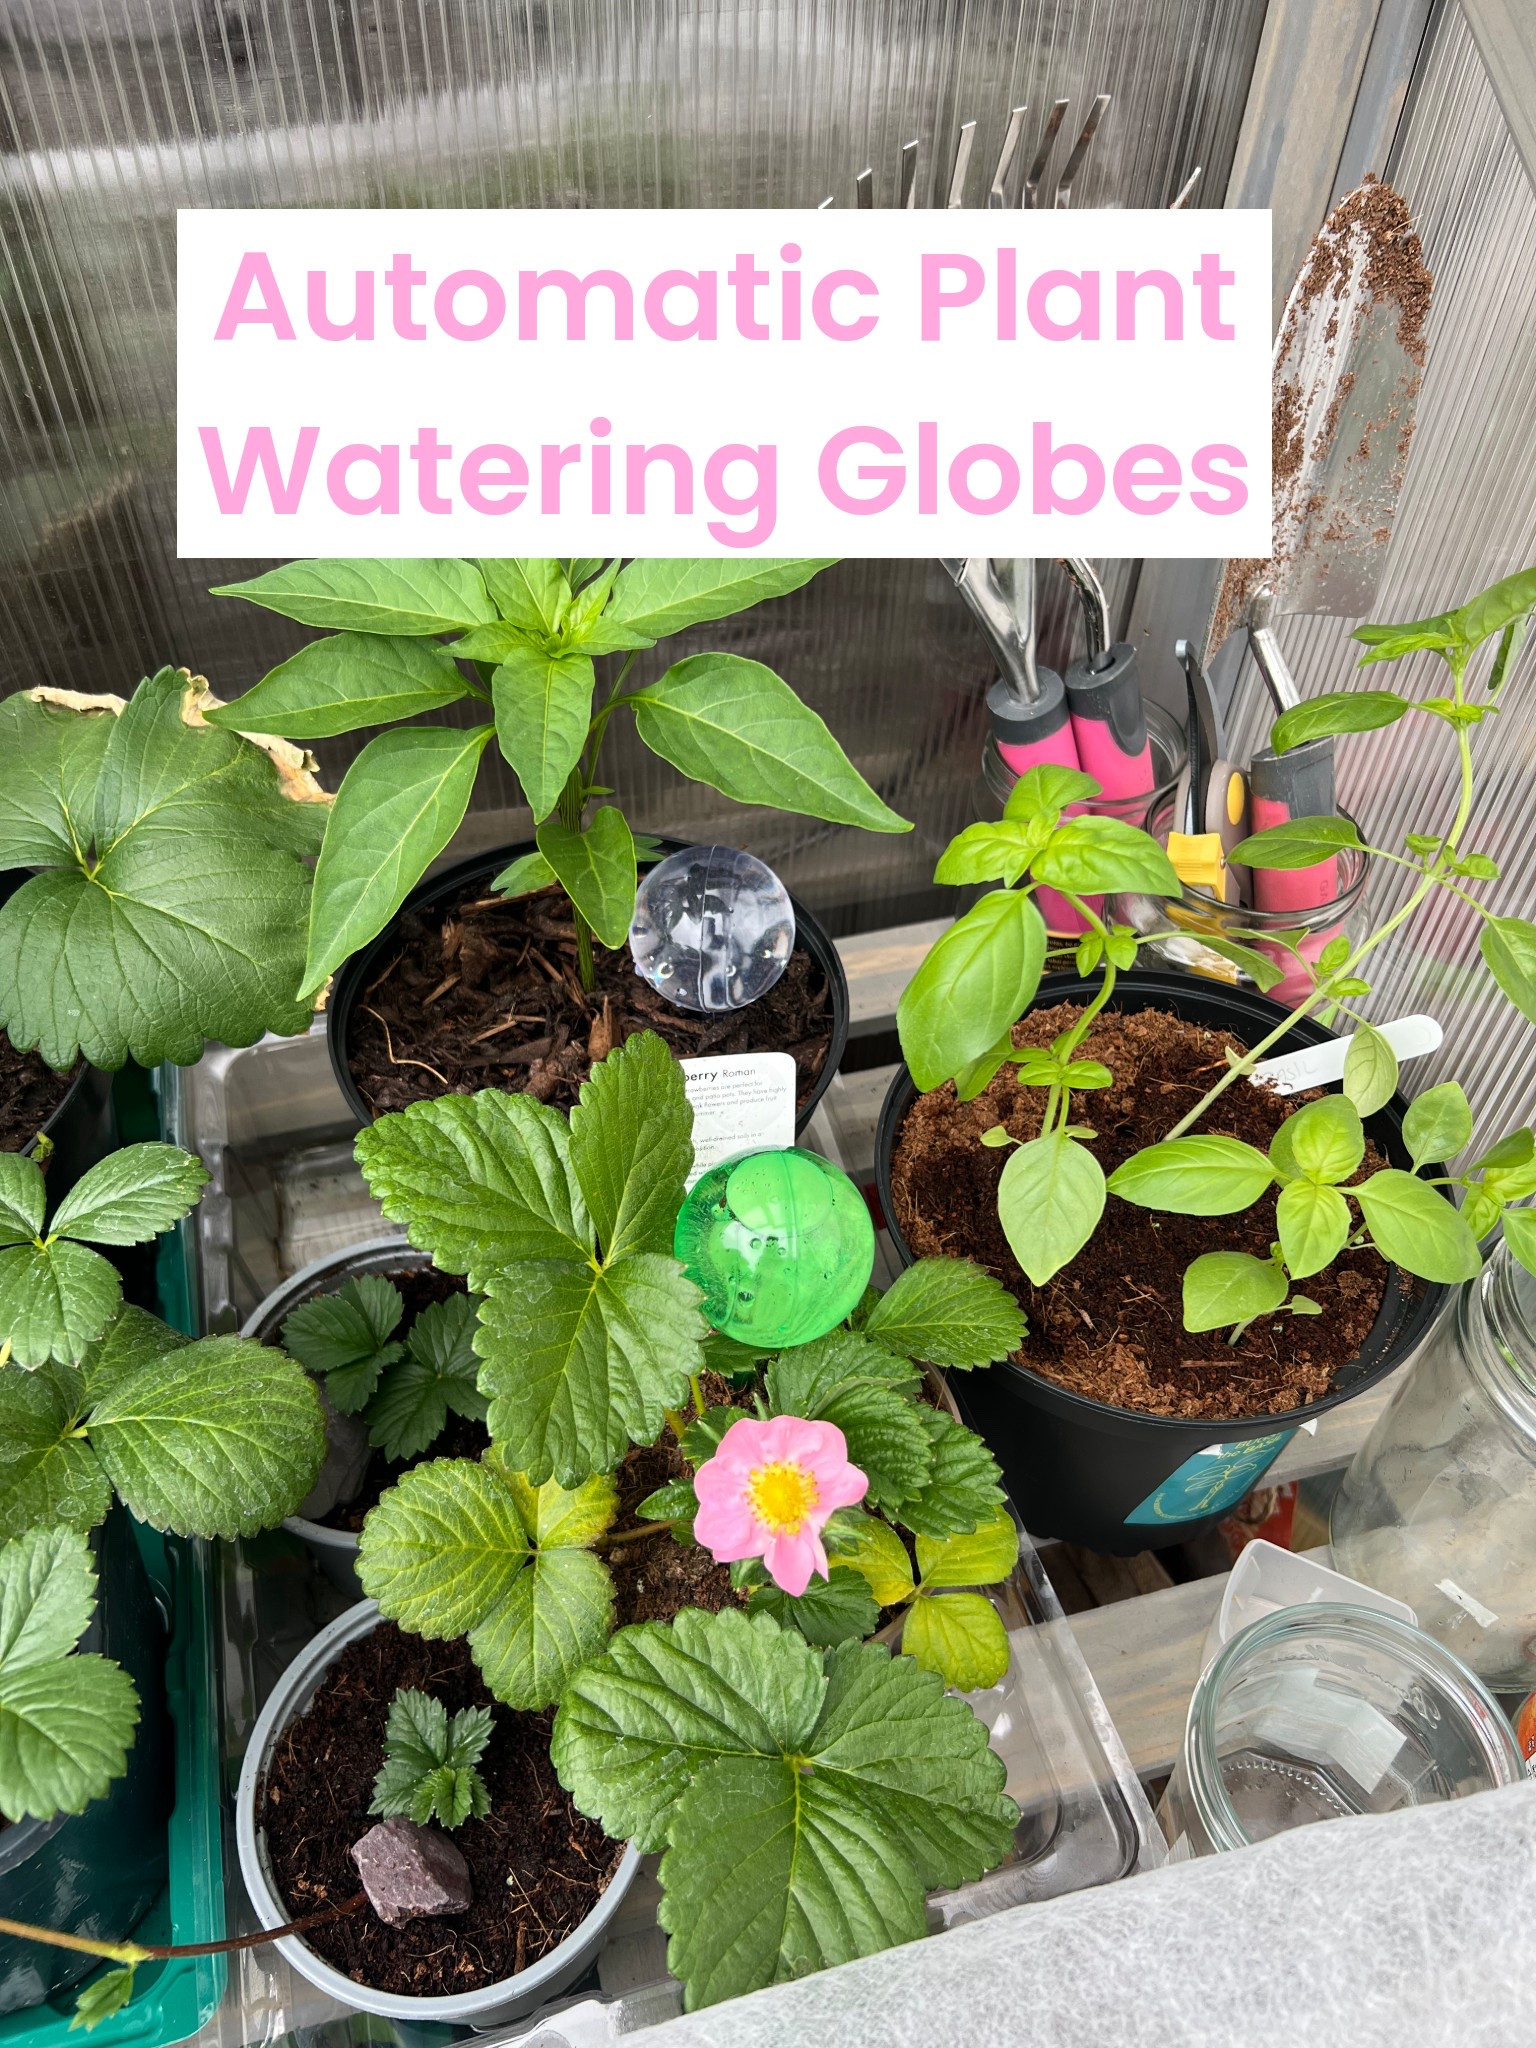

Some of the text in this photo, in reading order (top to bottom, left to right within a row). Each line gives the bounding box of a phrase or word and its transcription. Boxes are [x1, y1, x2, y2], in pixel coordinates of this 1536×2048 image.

[722, 1068, 756, 1078] Roman
[686, 1085, 719, 1094] rawberries
[732, 1082, 754, 1090] perfect
[768, 1086, 787, 1094] highly
